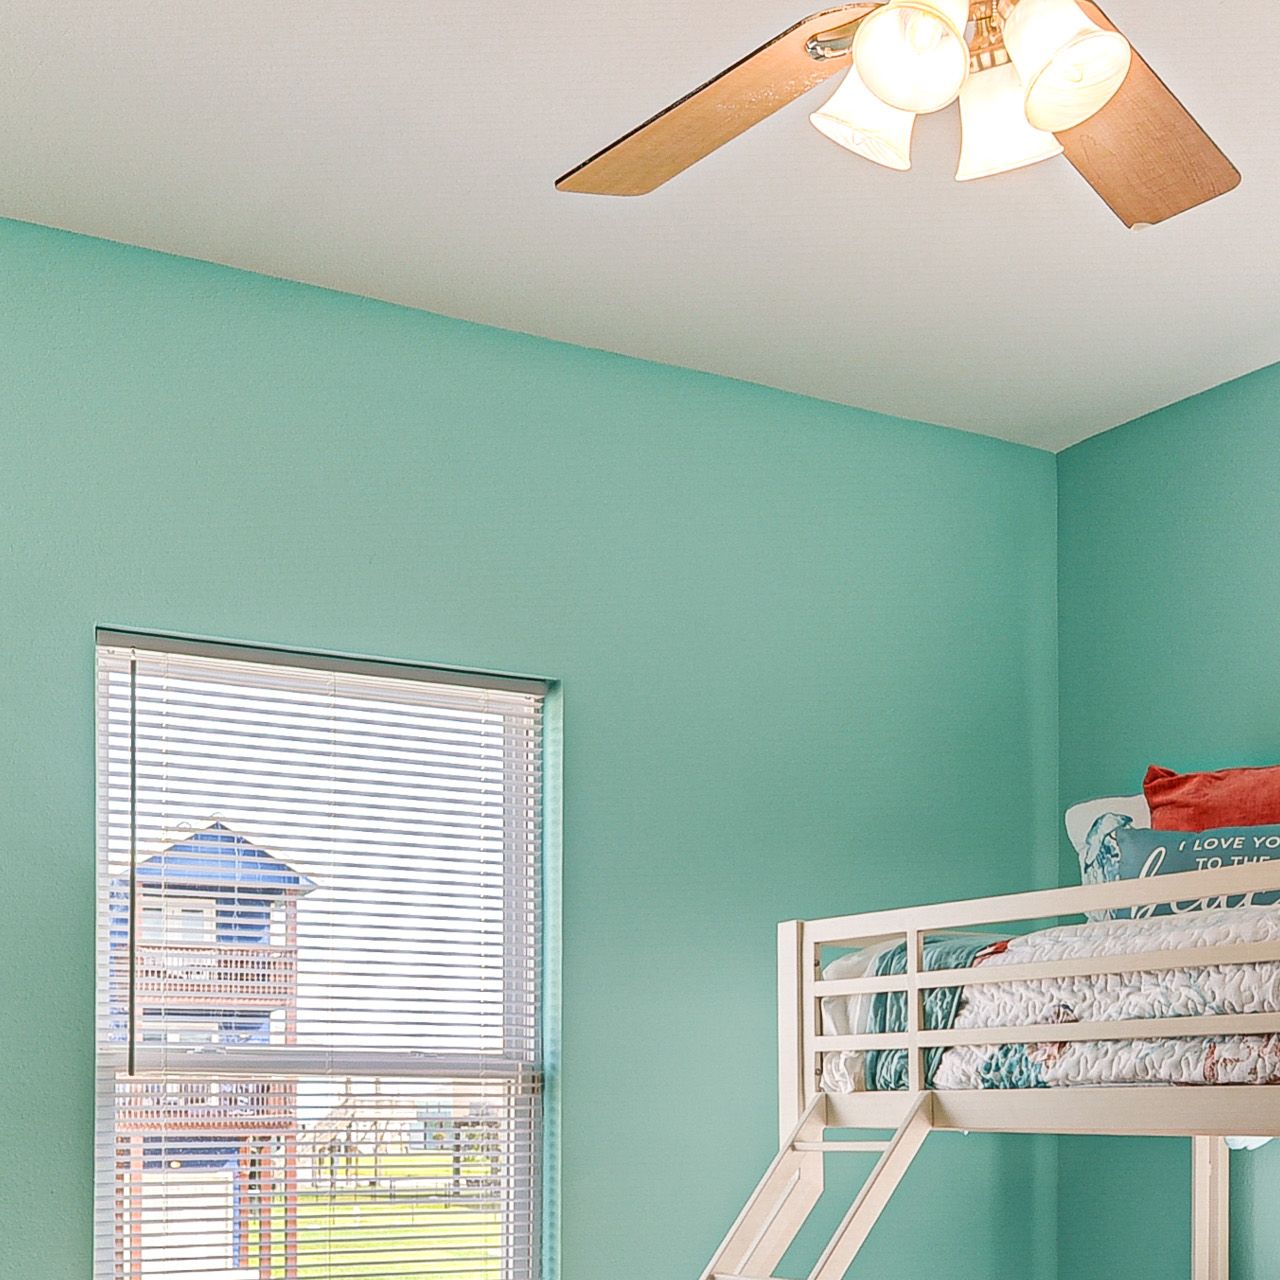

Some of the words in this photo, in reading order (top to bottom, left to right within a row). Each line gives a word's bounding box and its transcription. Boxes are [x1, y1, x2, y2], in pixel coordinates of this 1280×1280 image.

[1179, 841, 1186, 851] I
[1193, 837, 1245, 851] LOVE
[1196, 857, 1222, 870] TO
